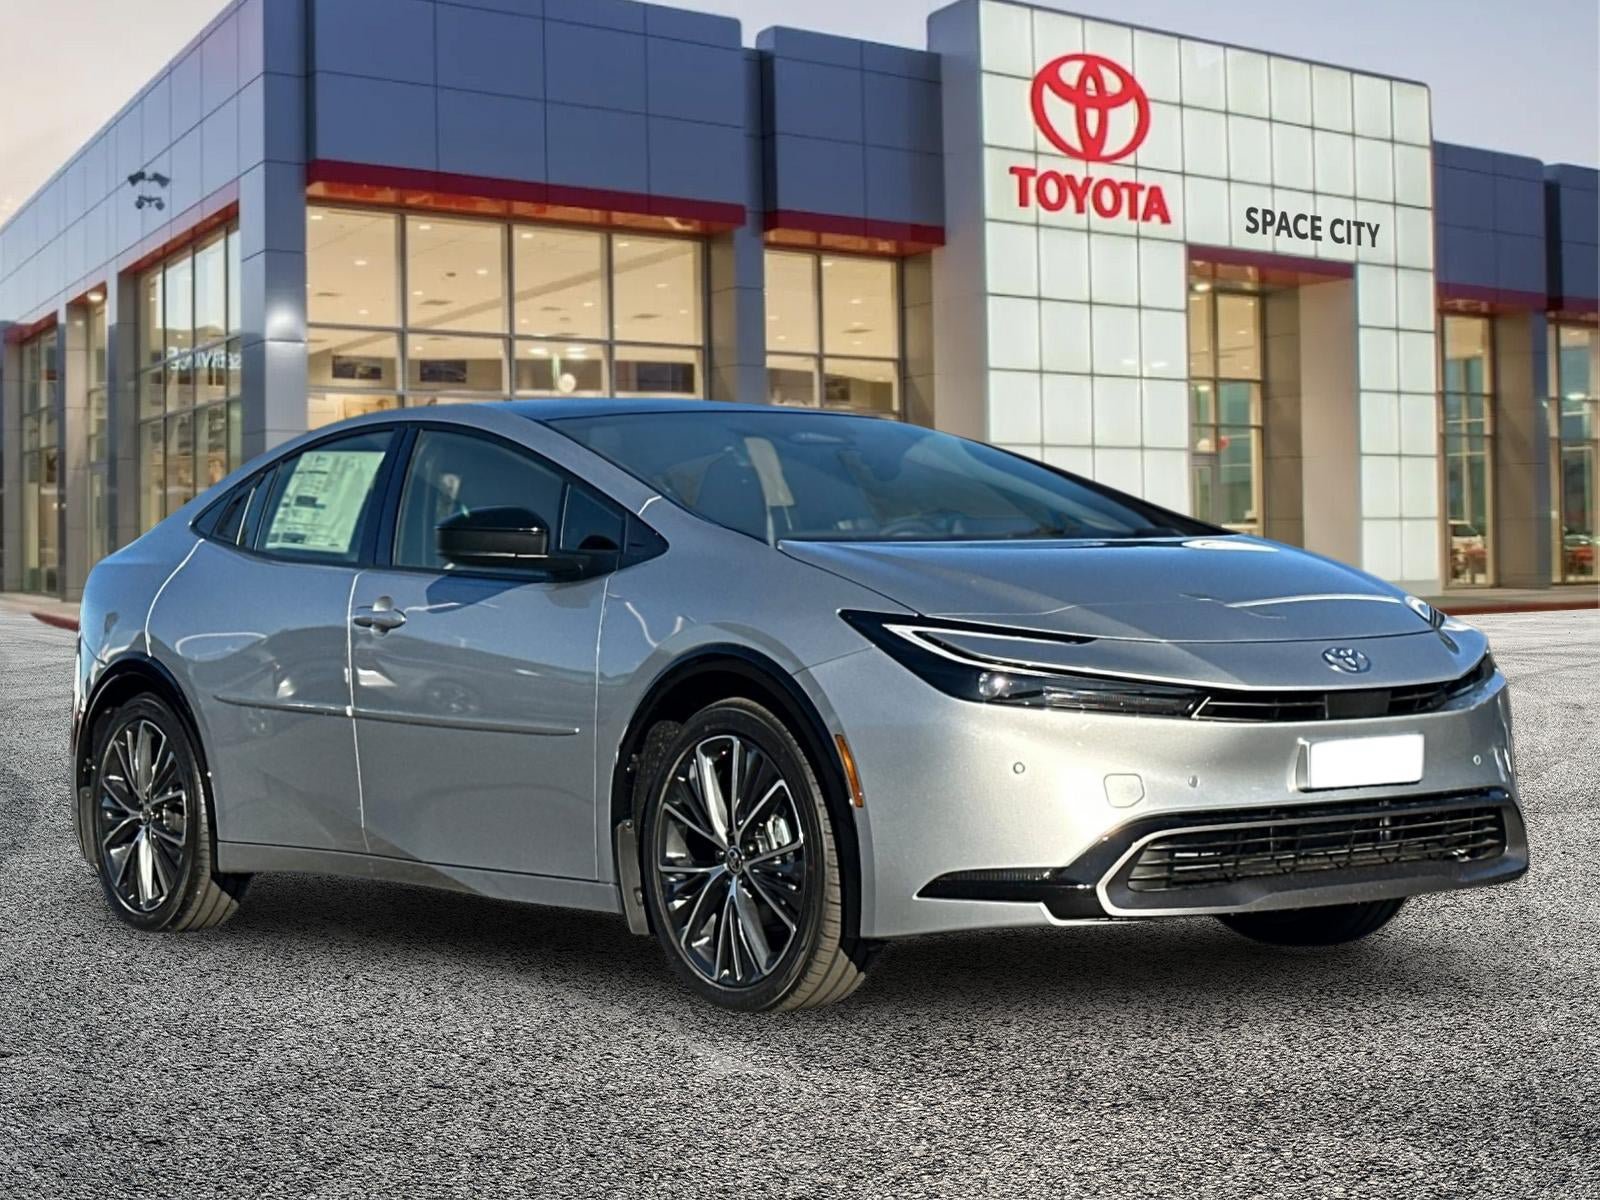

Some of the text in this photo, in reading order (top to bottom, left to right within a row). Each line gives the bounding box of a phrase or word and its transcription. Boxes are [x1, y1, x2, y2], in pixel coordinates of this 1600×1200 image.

[1009, 166, 1172, 225] TOYOTA
[1244, 206, 1381, 248] SPACE CITY
